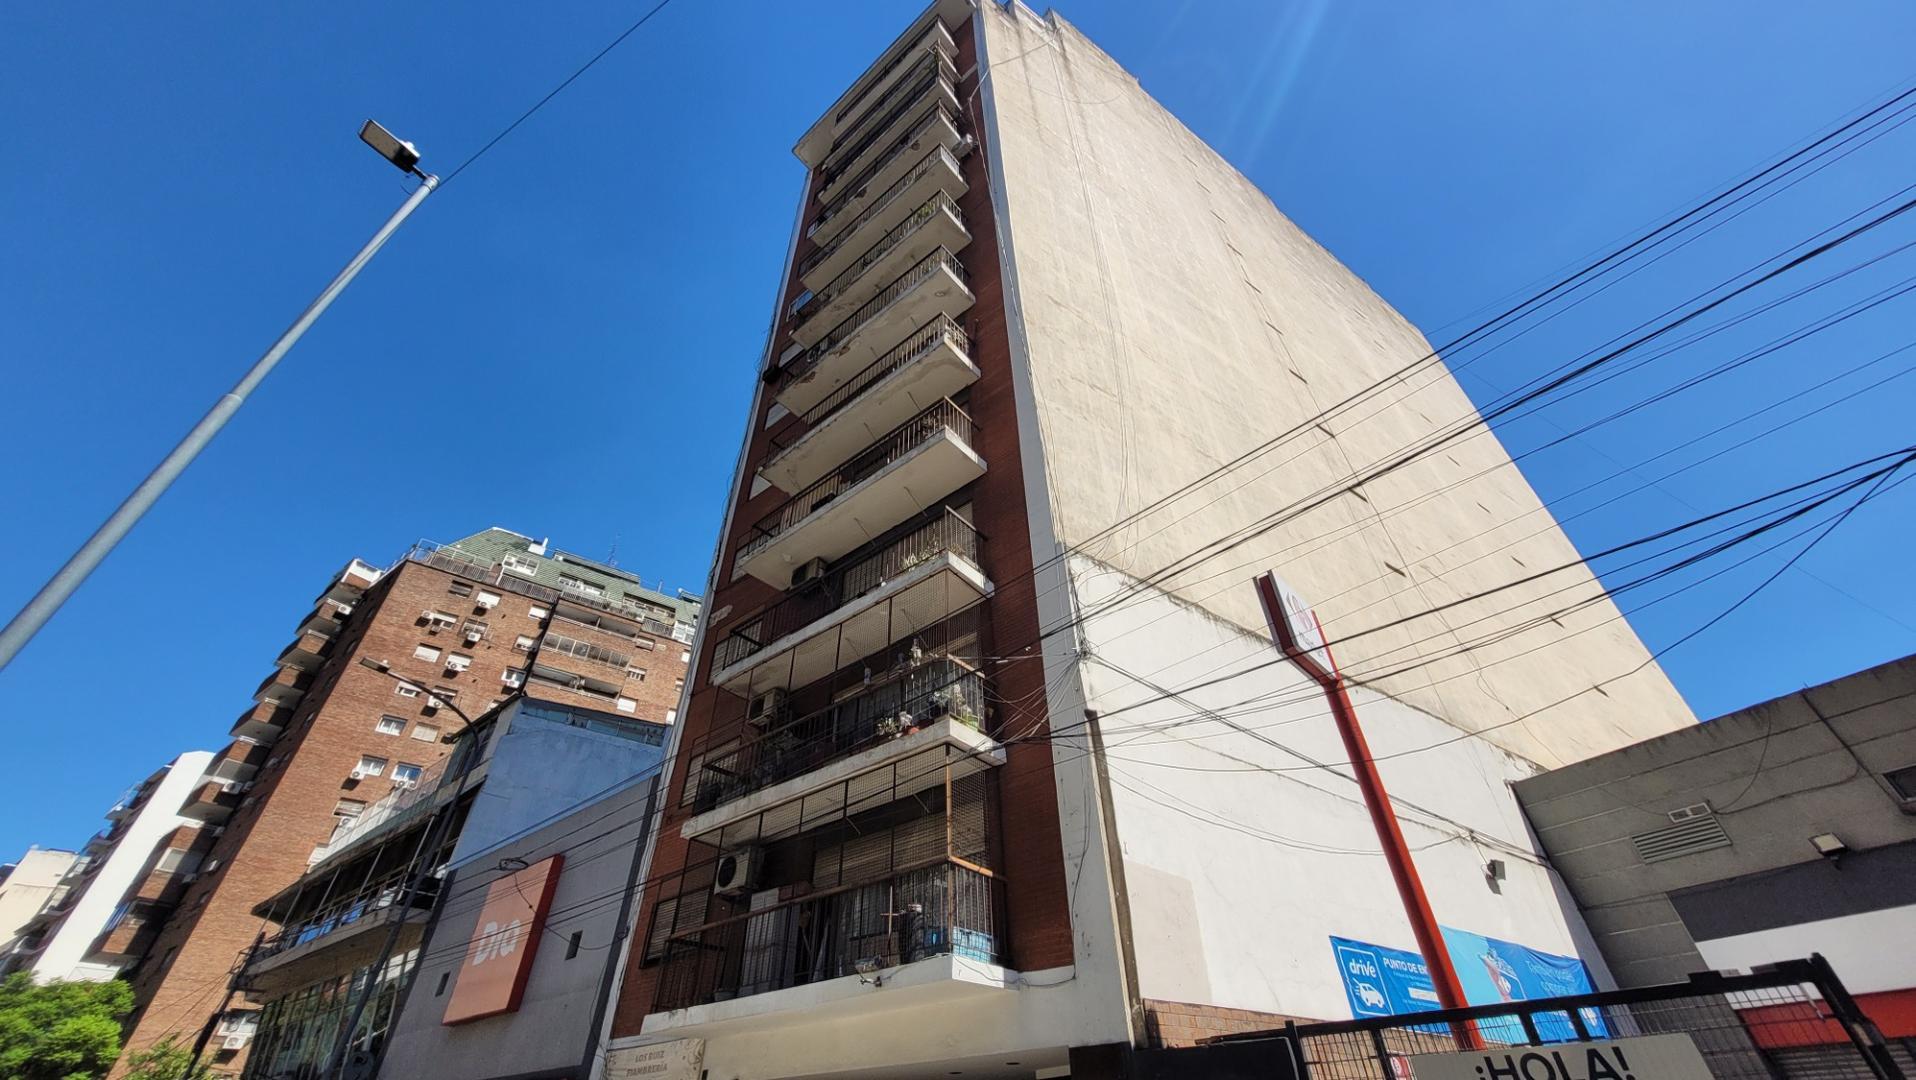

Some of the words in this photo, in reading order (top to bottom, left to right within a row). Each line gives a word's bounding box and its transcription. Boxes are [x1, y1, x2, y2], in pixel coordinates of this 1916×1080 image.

[1349, 957, 1377, 978] drive
[1382, 956, 1408, 971] PUNTO
[1406, 961, 1419, 974] DE
